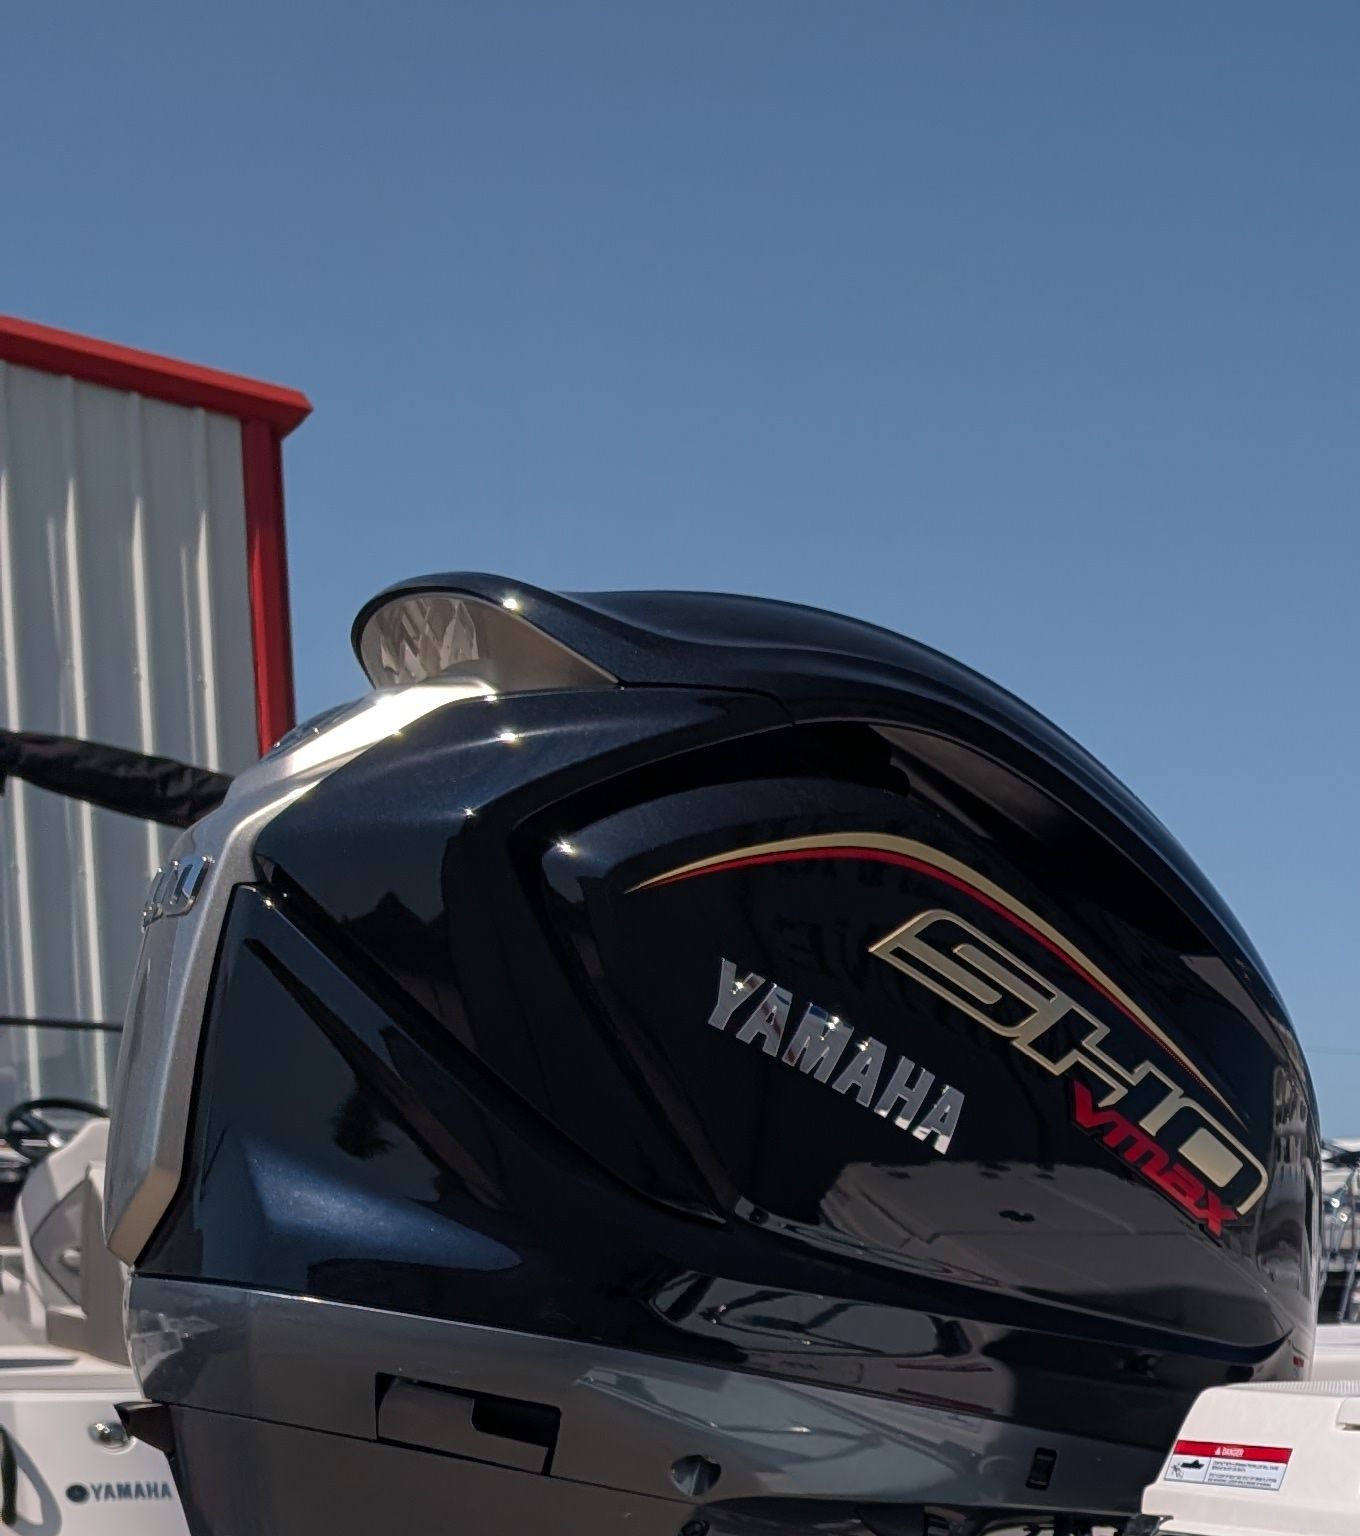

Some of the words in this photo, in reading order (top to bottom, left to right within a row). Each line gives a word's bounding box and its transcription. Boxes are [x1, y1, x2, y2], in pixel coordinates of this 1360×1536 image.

[707, 957, 965, 1155] YAMAHA
[867, 908, 1268, 1215] SHO
[90, 1481, 173, 1500] YAMAHA
